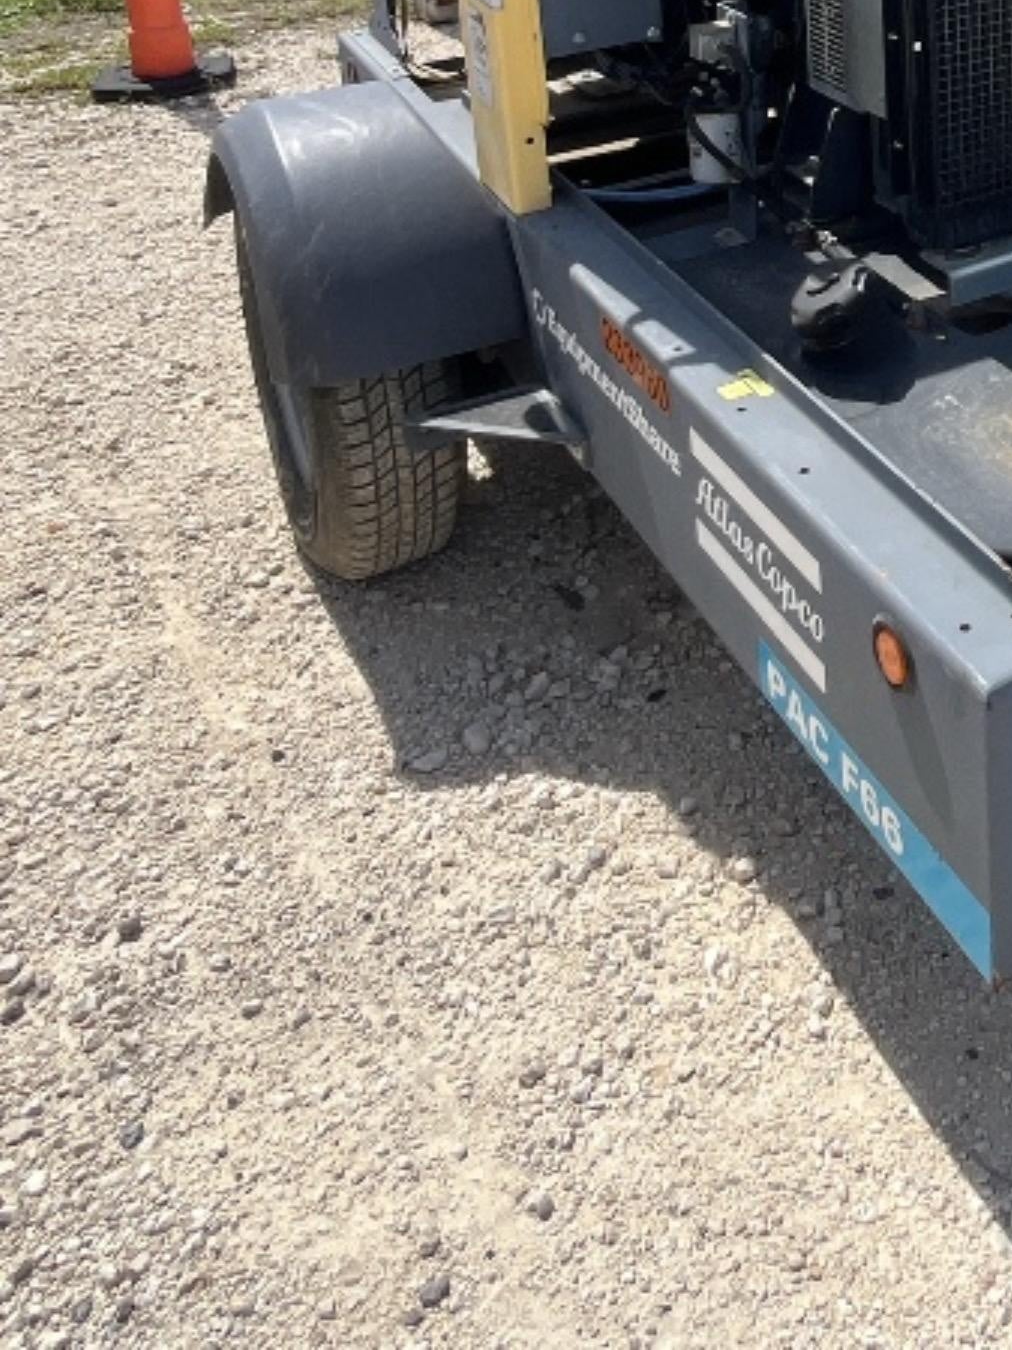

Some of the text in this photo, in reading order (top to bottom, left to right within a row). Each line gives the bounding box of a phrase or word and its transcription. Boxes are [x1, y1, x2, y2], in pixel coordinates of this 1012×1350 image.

[696, 478, 825, 643] Atlas Copco
[766, 659, 904, 856] PAC F66
